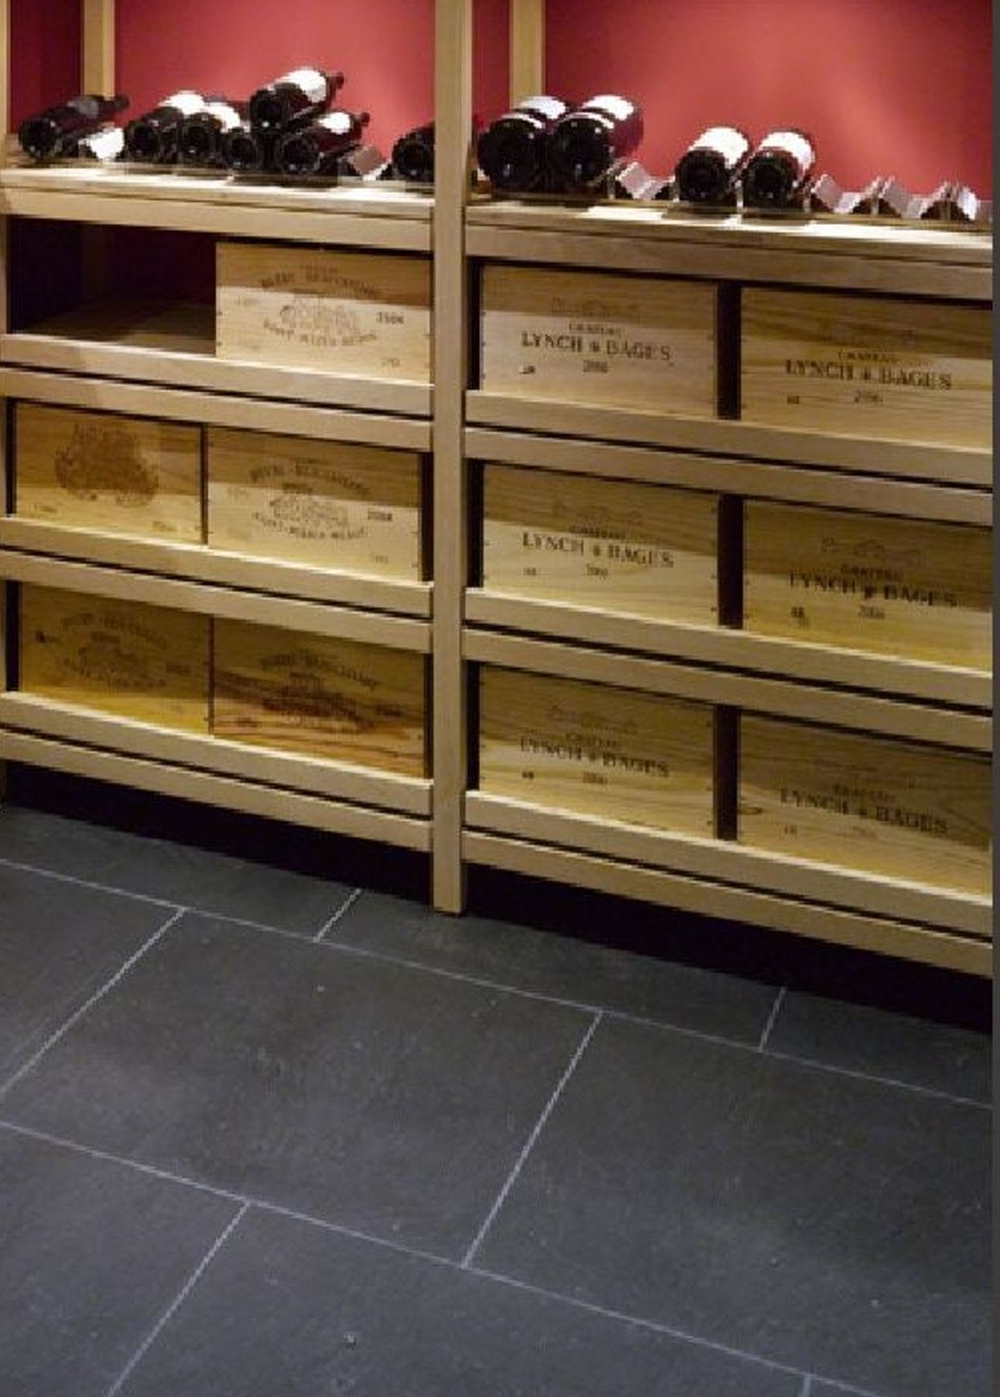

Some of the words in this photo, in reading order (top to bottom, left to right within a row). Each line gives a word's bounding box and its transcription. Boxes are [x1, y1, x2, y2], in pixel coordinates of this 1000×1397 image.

[521, 331, 583, 353] LYNCH
[605, 340, 671, 362] BAGES
[785, 359, 854, 381] LYNCH
[879, 367, 953, 390] BAGES
[522, 532, 585, 556] LYNCH
[607, 545, 675, 568] BAGES
